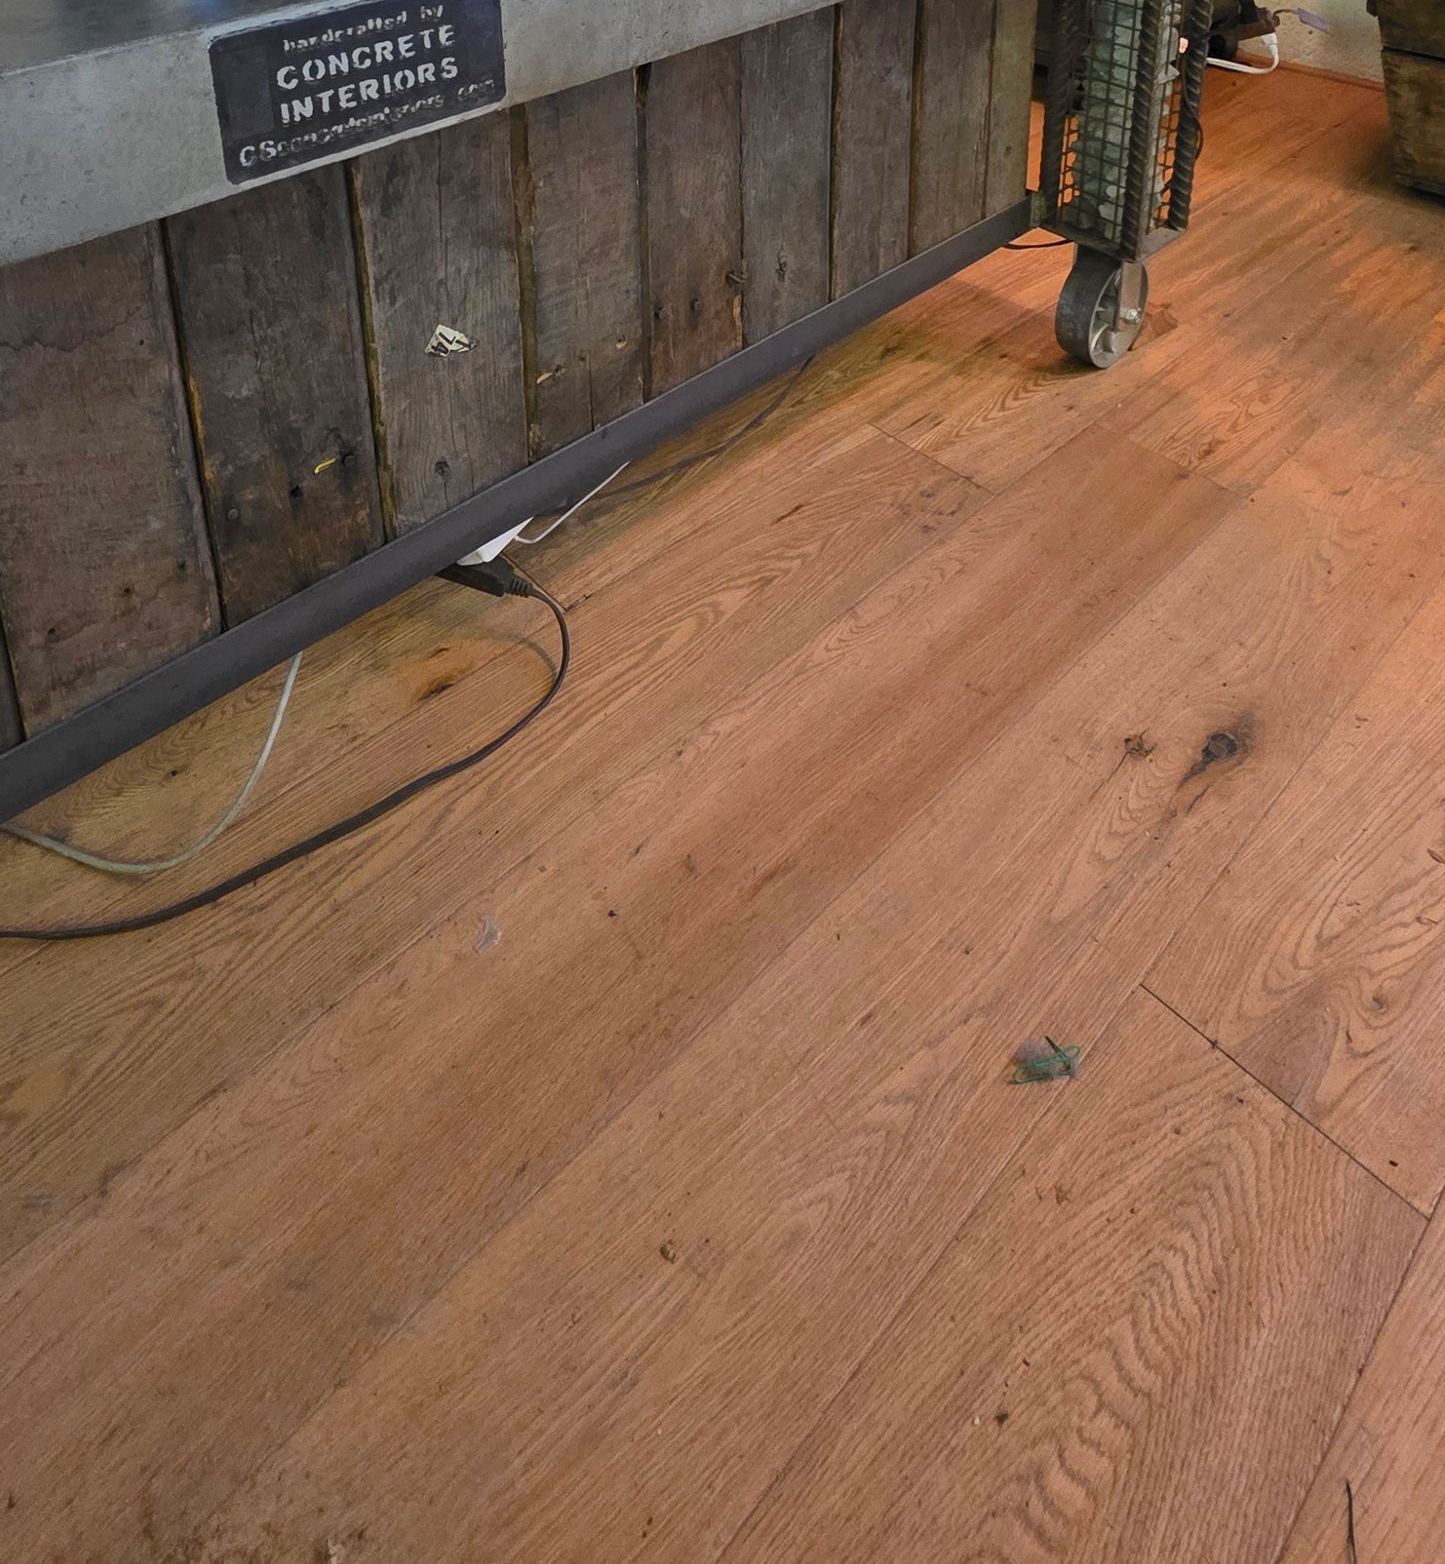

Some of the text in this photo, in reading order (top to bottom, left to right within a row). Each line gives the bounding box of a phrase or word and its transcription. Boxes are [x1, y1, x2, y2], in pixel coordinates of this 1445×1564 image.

[420, 4, 443, 22] by
[276, 24, 456, 90] CONCRETE
[280, 56, 460, 125] INTERIORS
